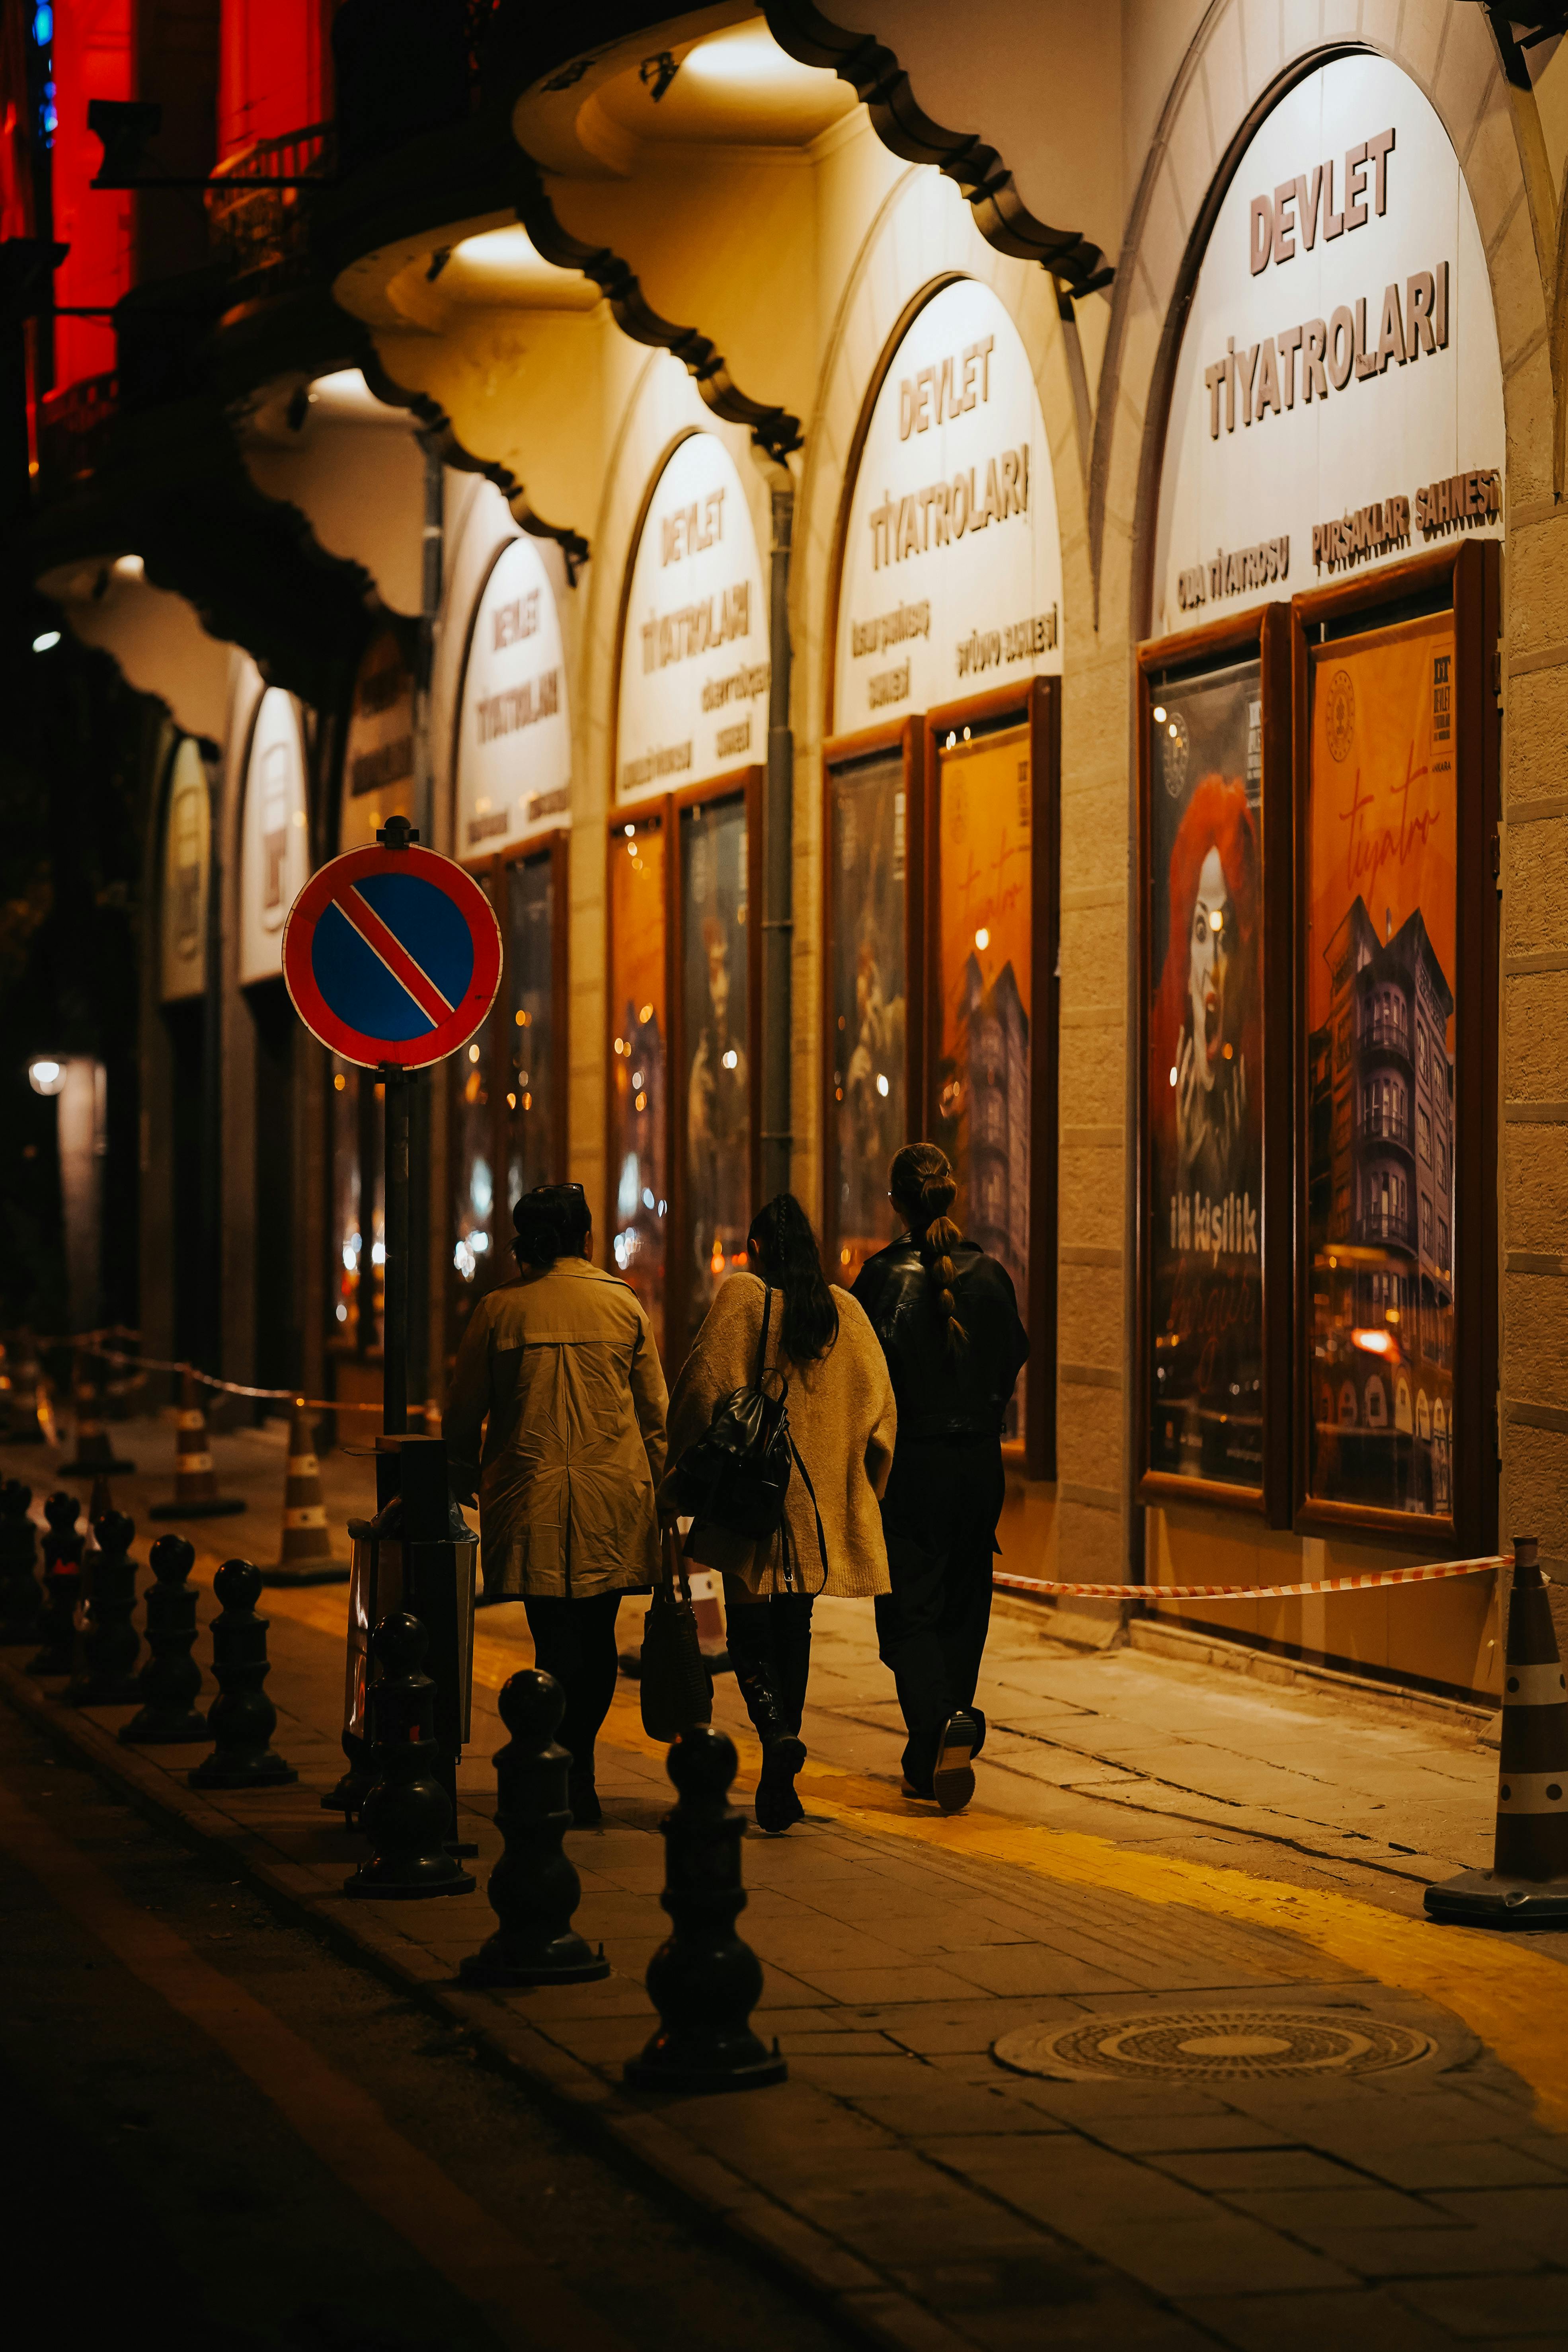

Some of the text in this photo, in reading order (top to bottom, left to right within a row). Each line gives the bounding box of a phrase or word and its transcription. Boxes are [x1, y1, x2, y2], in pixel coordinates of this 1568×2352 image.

[1250, 128, 1396, 276] DEVLET
[899, 335, 995, 441] DEVLET
[1205, 261, 1450, 440] TİYATROLARI
[869, 443, 1029, 571] TİYATROLARI
[1312, 468, 1502, 567] PURSAKLAR SAHNESİ
